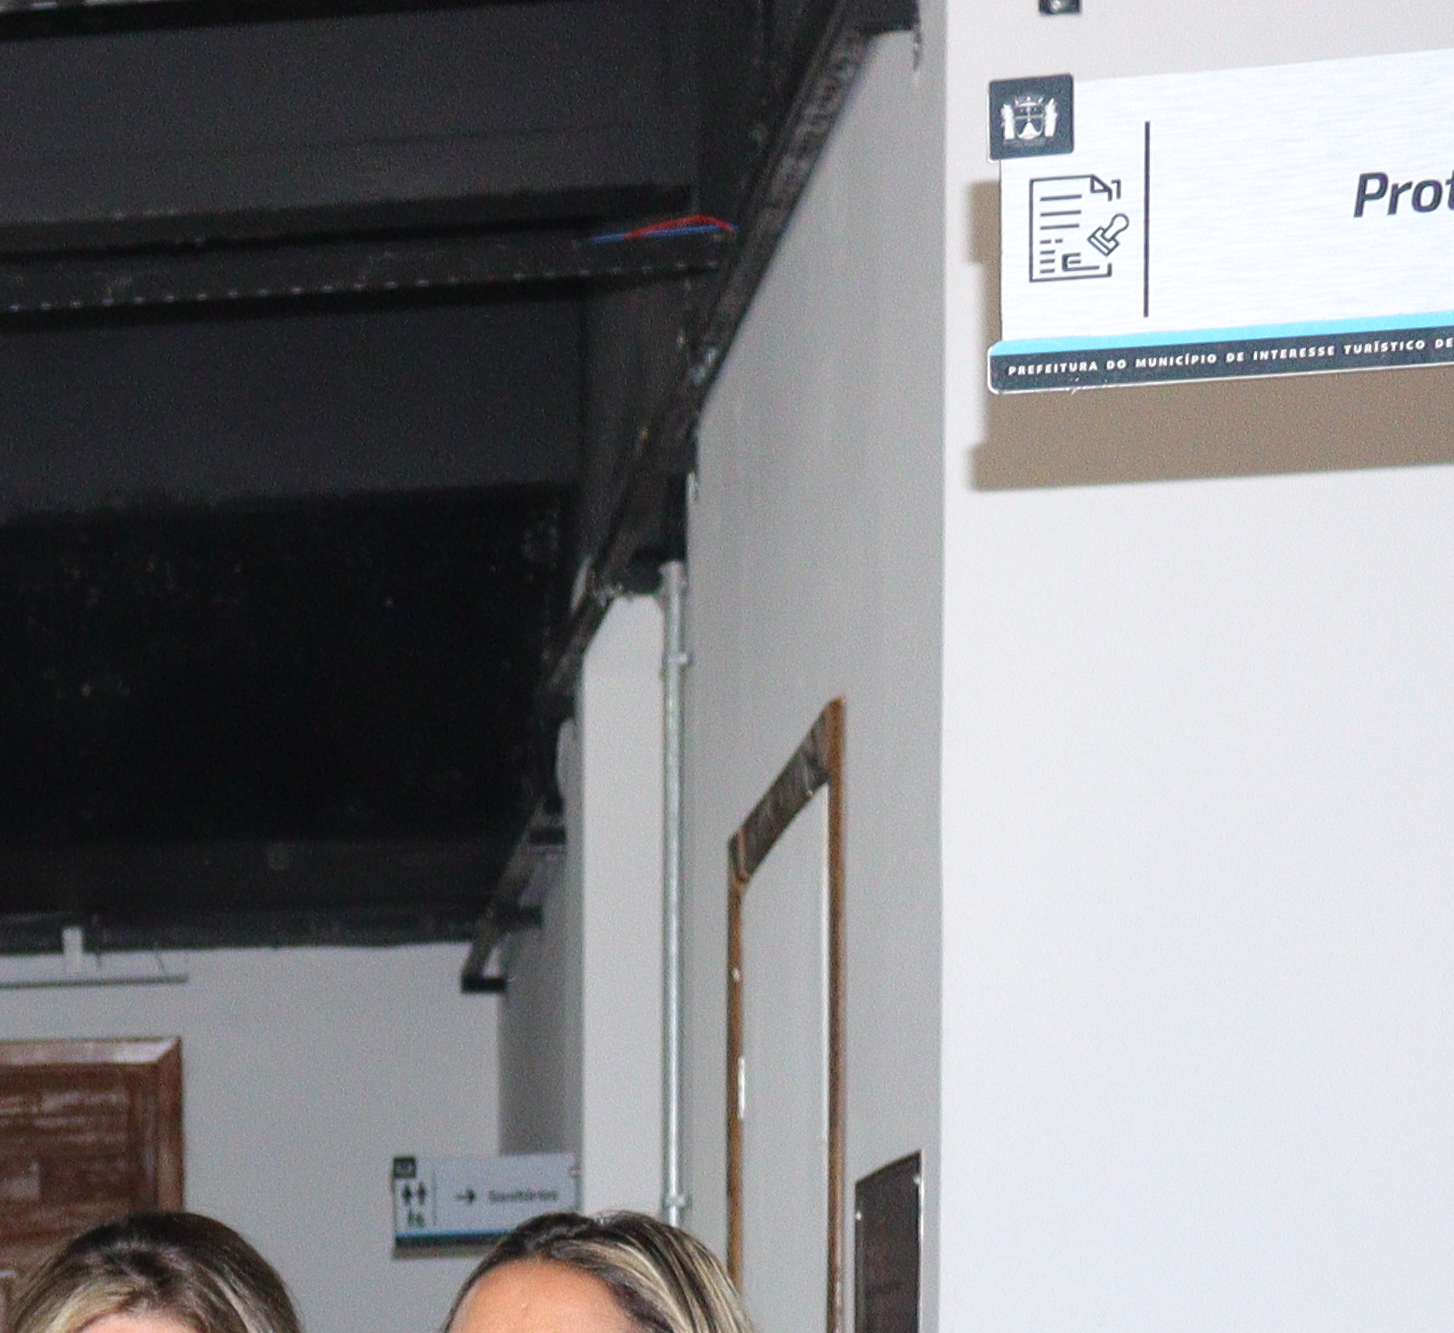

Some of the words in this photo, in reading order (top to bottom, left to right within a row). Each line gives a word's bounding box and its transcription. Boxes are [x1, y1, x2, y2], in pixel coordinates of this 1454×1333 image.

[1008, 360, 1099, 376] PREFEITURA
[1106, 357, 1128, 371] DO
[1136, 353, 1218, 370] MUNICÍPIO
[1226, 351, 1245, 362] DE
[1253, 345, 1336, 362] INTERESSE
[1344, 339, 1426, 356] TURÍSTICO
[1434, 337, 1453, 349] DE
